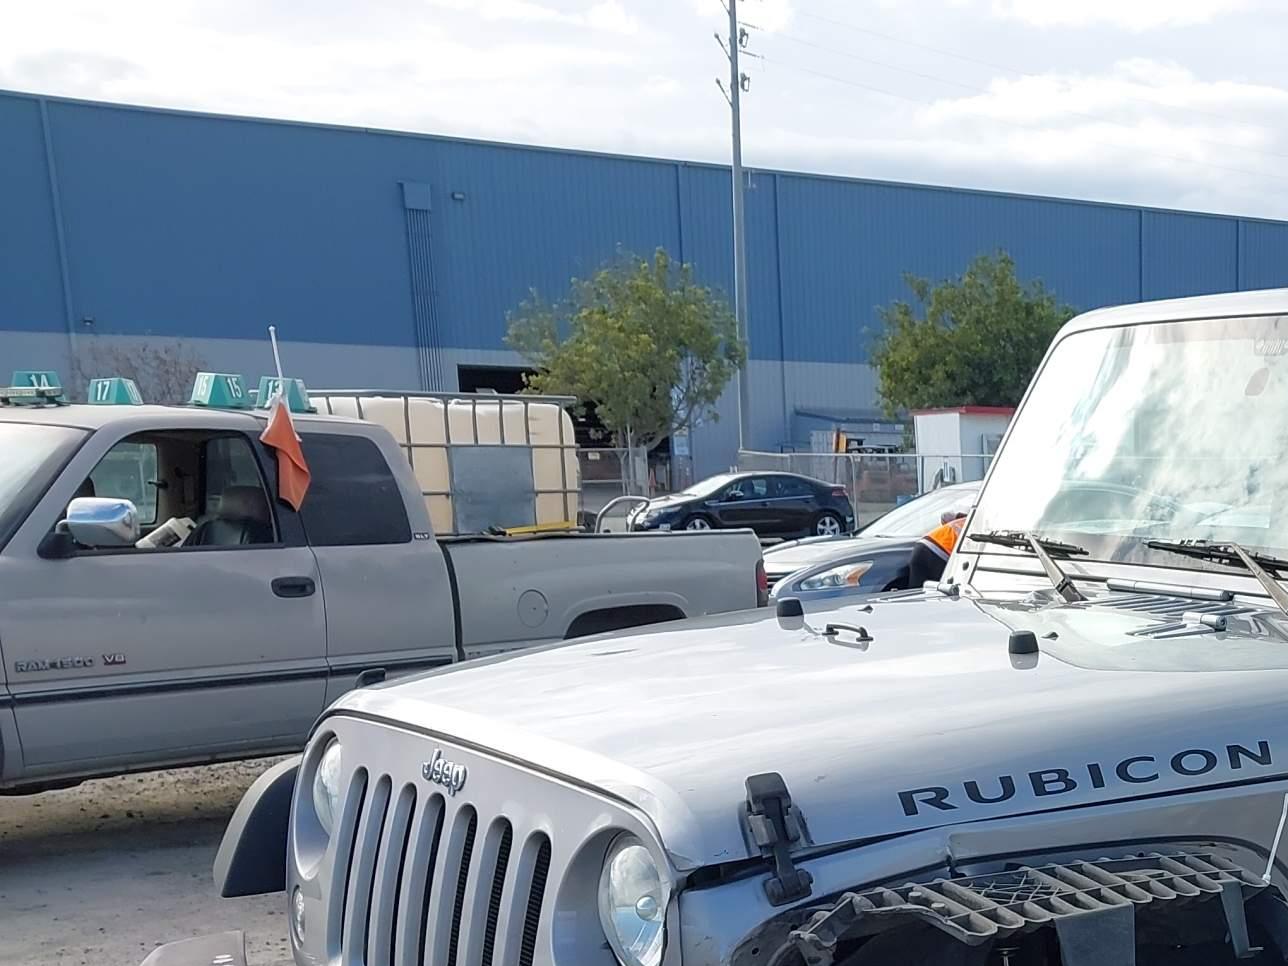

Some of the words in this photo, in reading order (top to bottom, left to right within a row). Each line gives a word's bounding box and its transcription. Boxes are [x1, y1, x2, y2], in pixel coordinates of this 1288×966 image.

[97, 381, 110, 401] 17
[227, 377, 243, 398] 15
[422, 748, 467, 797] Jeep
[897, 740, 1273, 817] RUBICON
